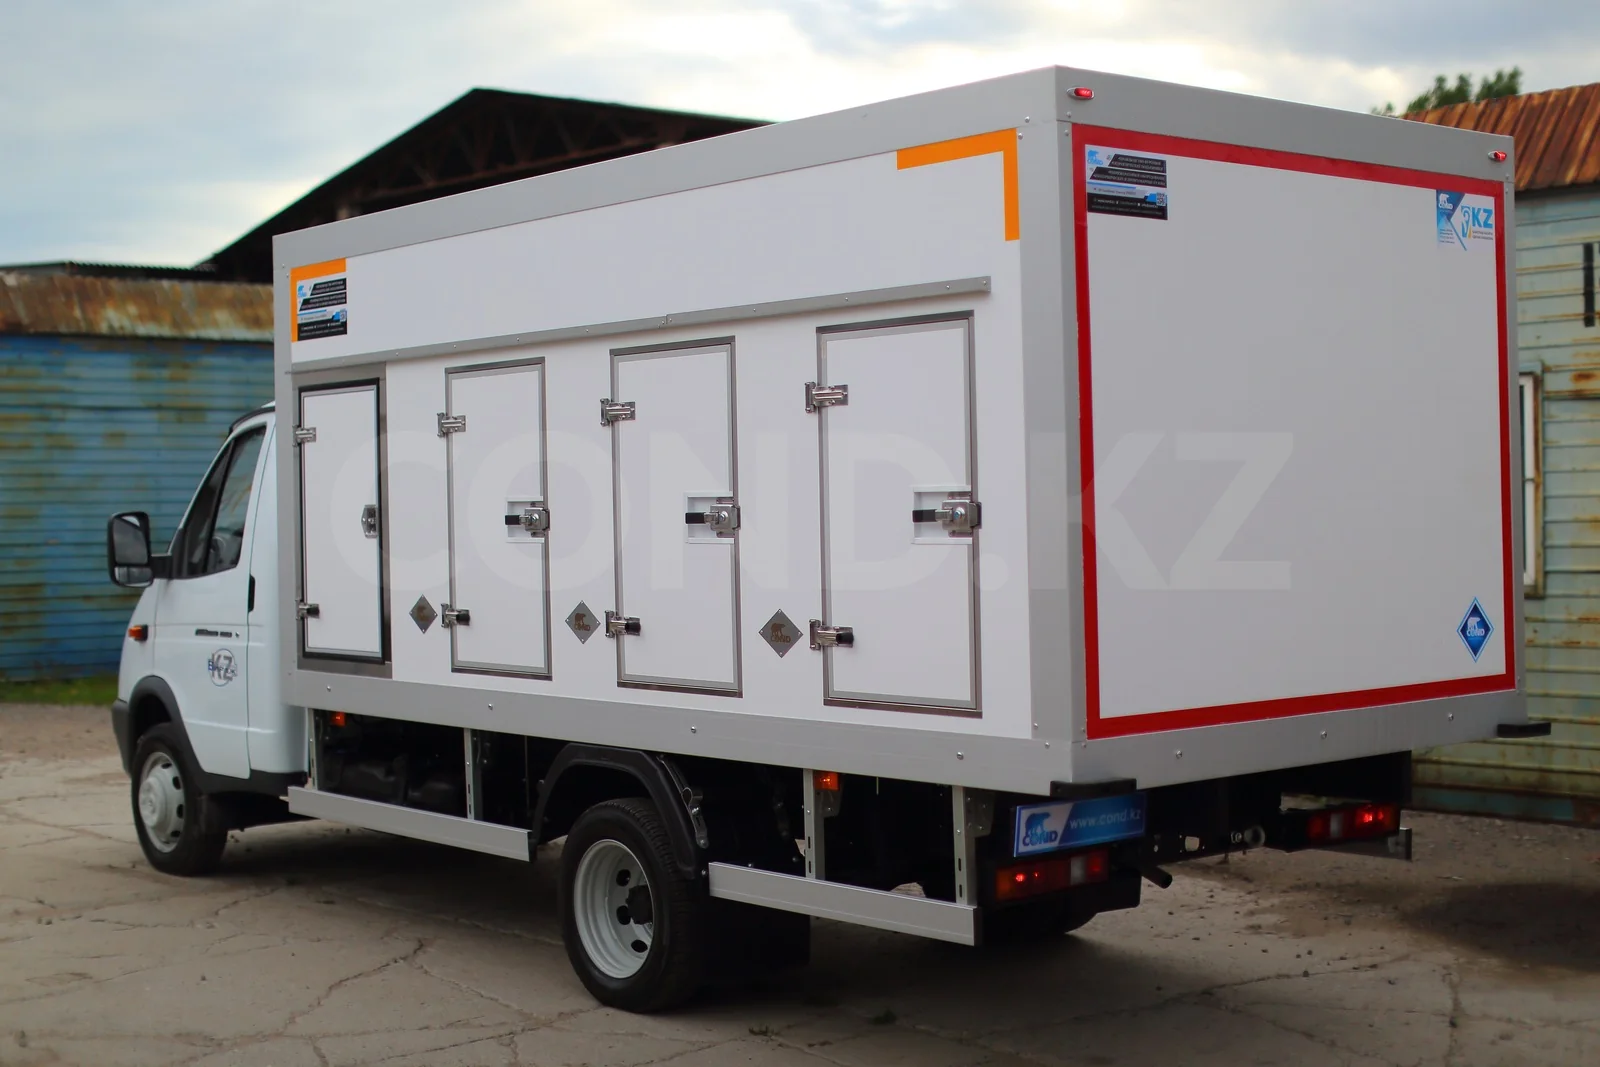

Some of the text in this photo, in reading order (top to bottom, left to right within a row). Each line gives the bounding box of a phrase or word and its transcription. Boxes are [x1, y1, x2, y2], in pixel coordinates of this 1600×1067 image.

[1471, 207, 1494, 229] KZ
[1069, 807, 1142, 829] www.cond.kz
[1022, 830, 1059, 847] COND
